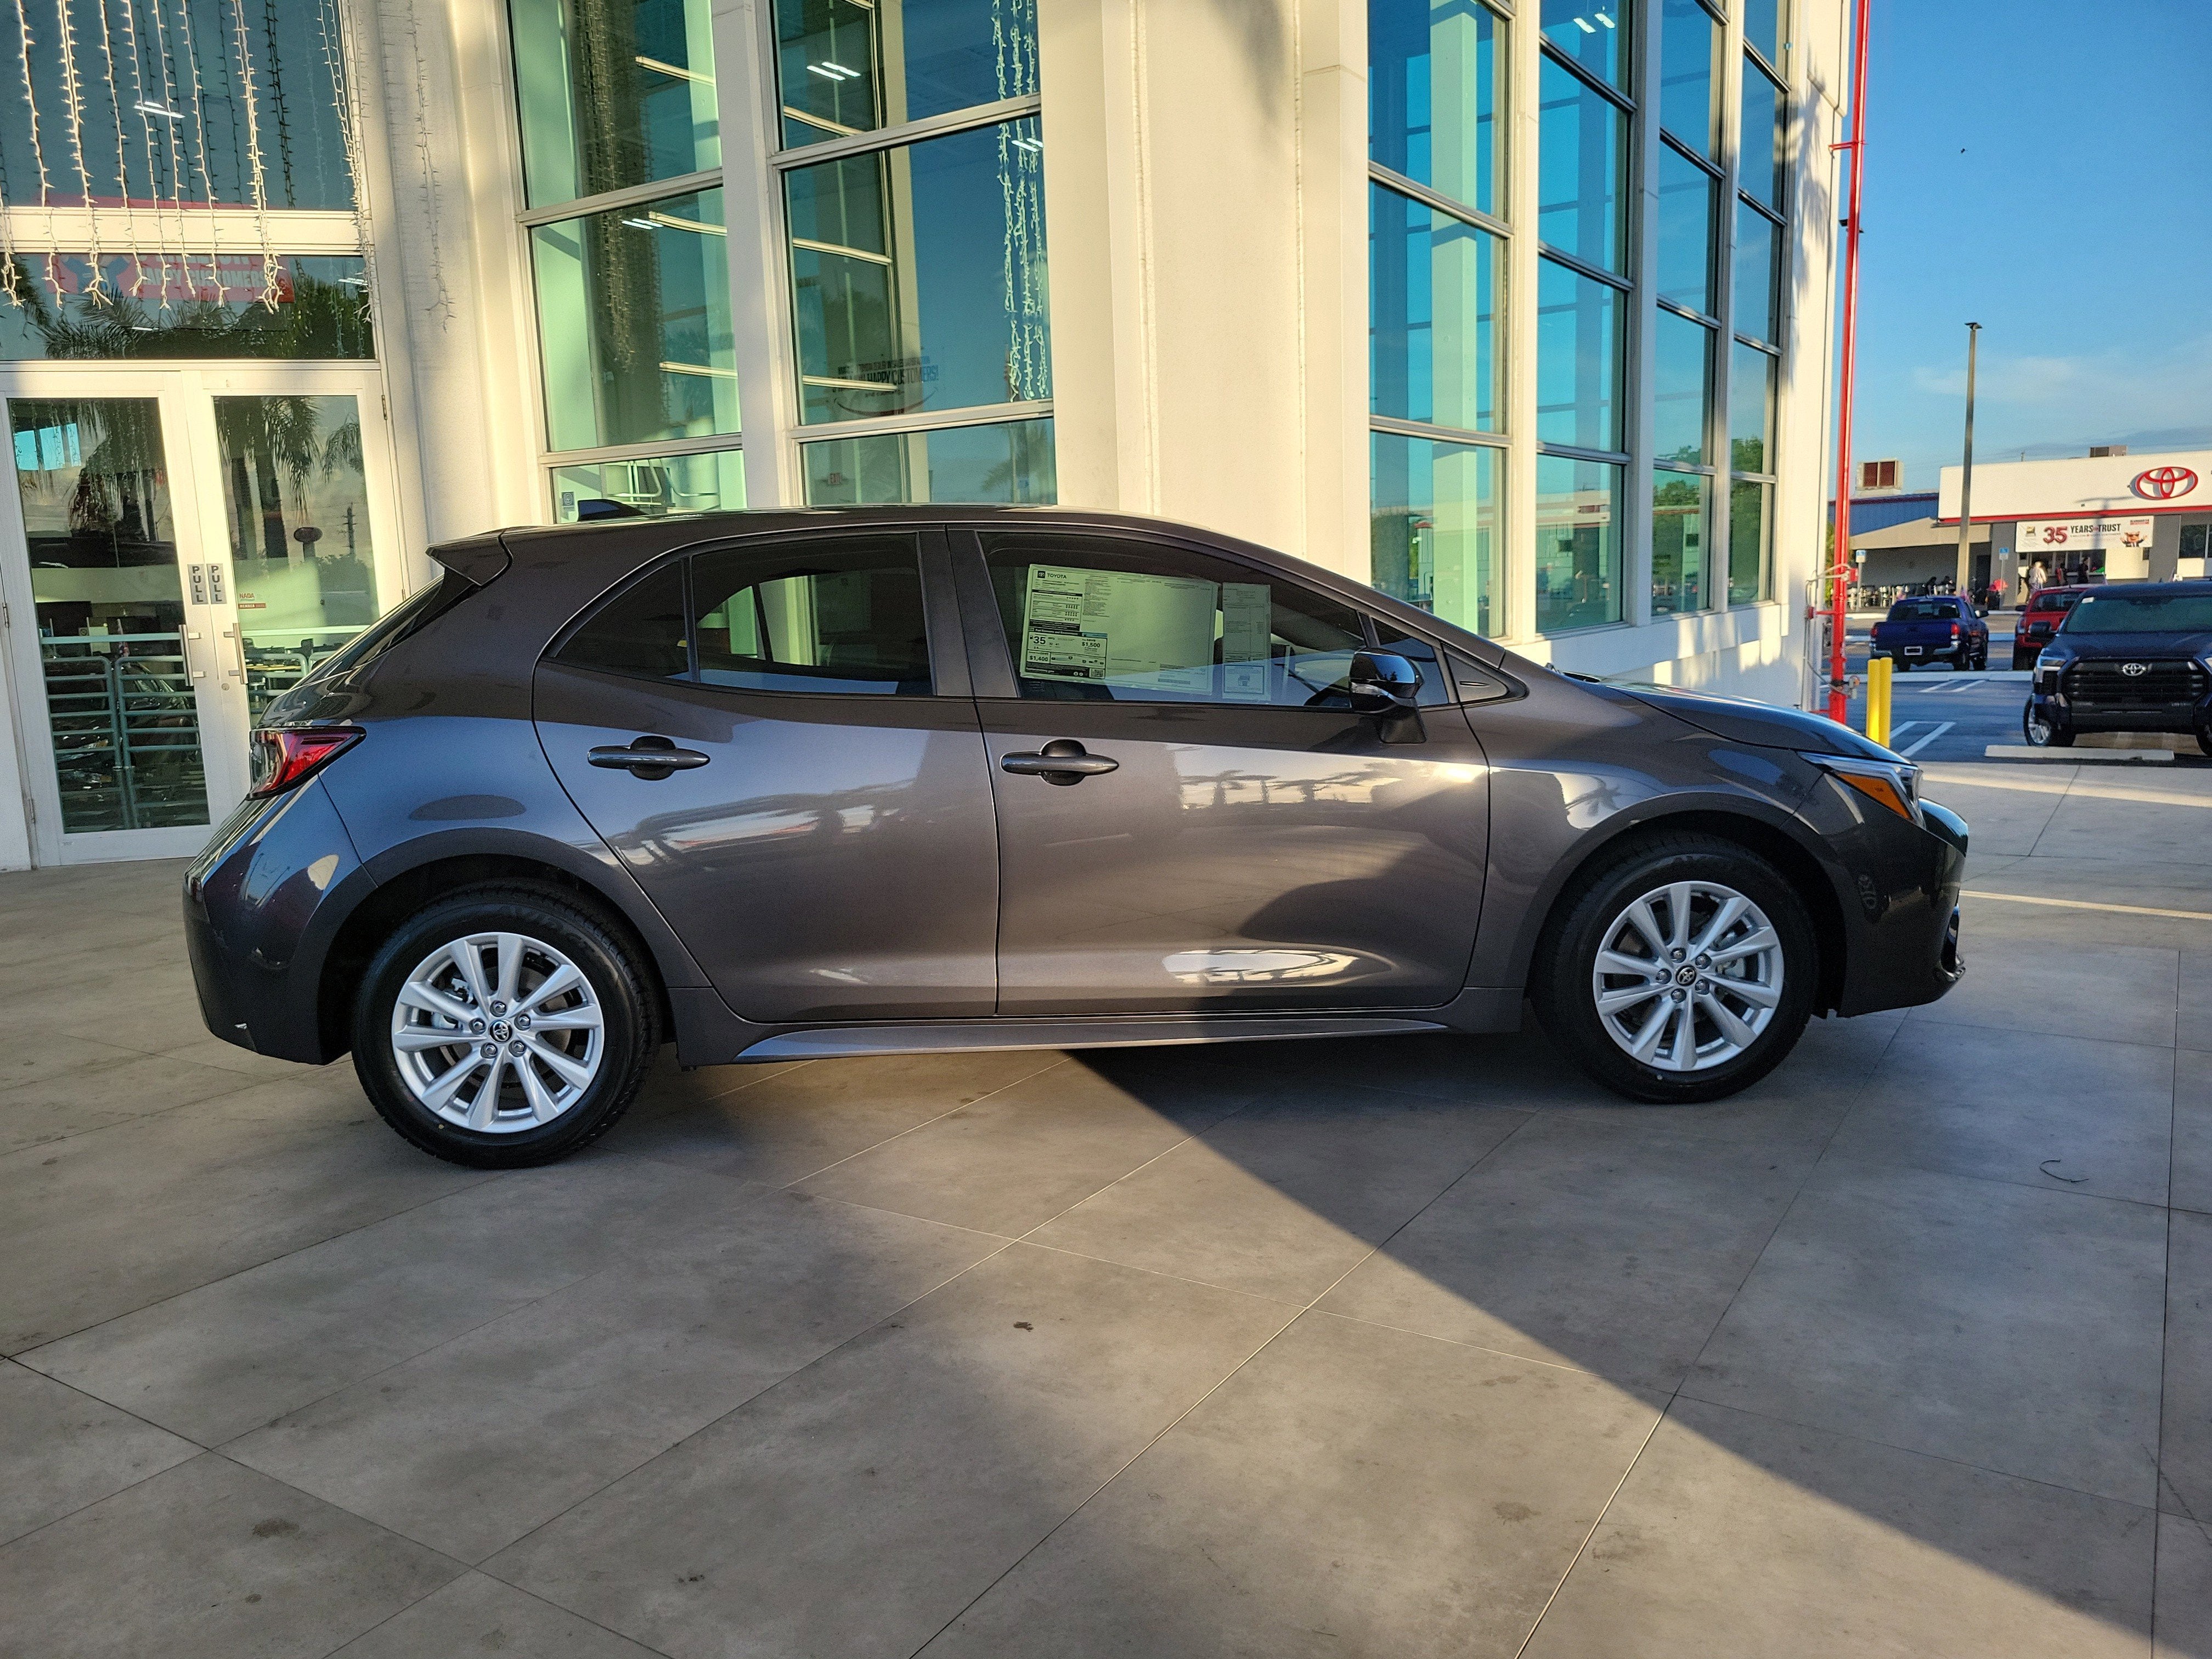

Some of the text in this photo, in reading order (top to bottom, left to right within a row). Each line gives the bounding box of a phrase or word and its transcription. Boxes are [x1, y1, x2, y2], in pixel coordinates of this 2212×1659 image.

[2042, 526, 2068, 544] 35
[2070, 525, 2093, 533] YEARS
[2097, 523, 2121, 532] TRUST
[192, 566, 204, 602] PULL
[211, 565, 222, 602] PULL
[1033, 636, 1046, 645] 35
